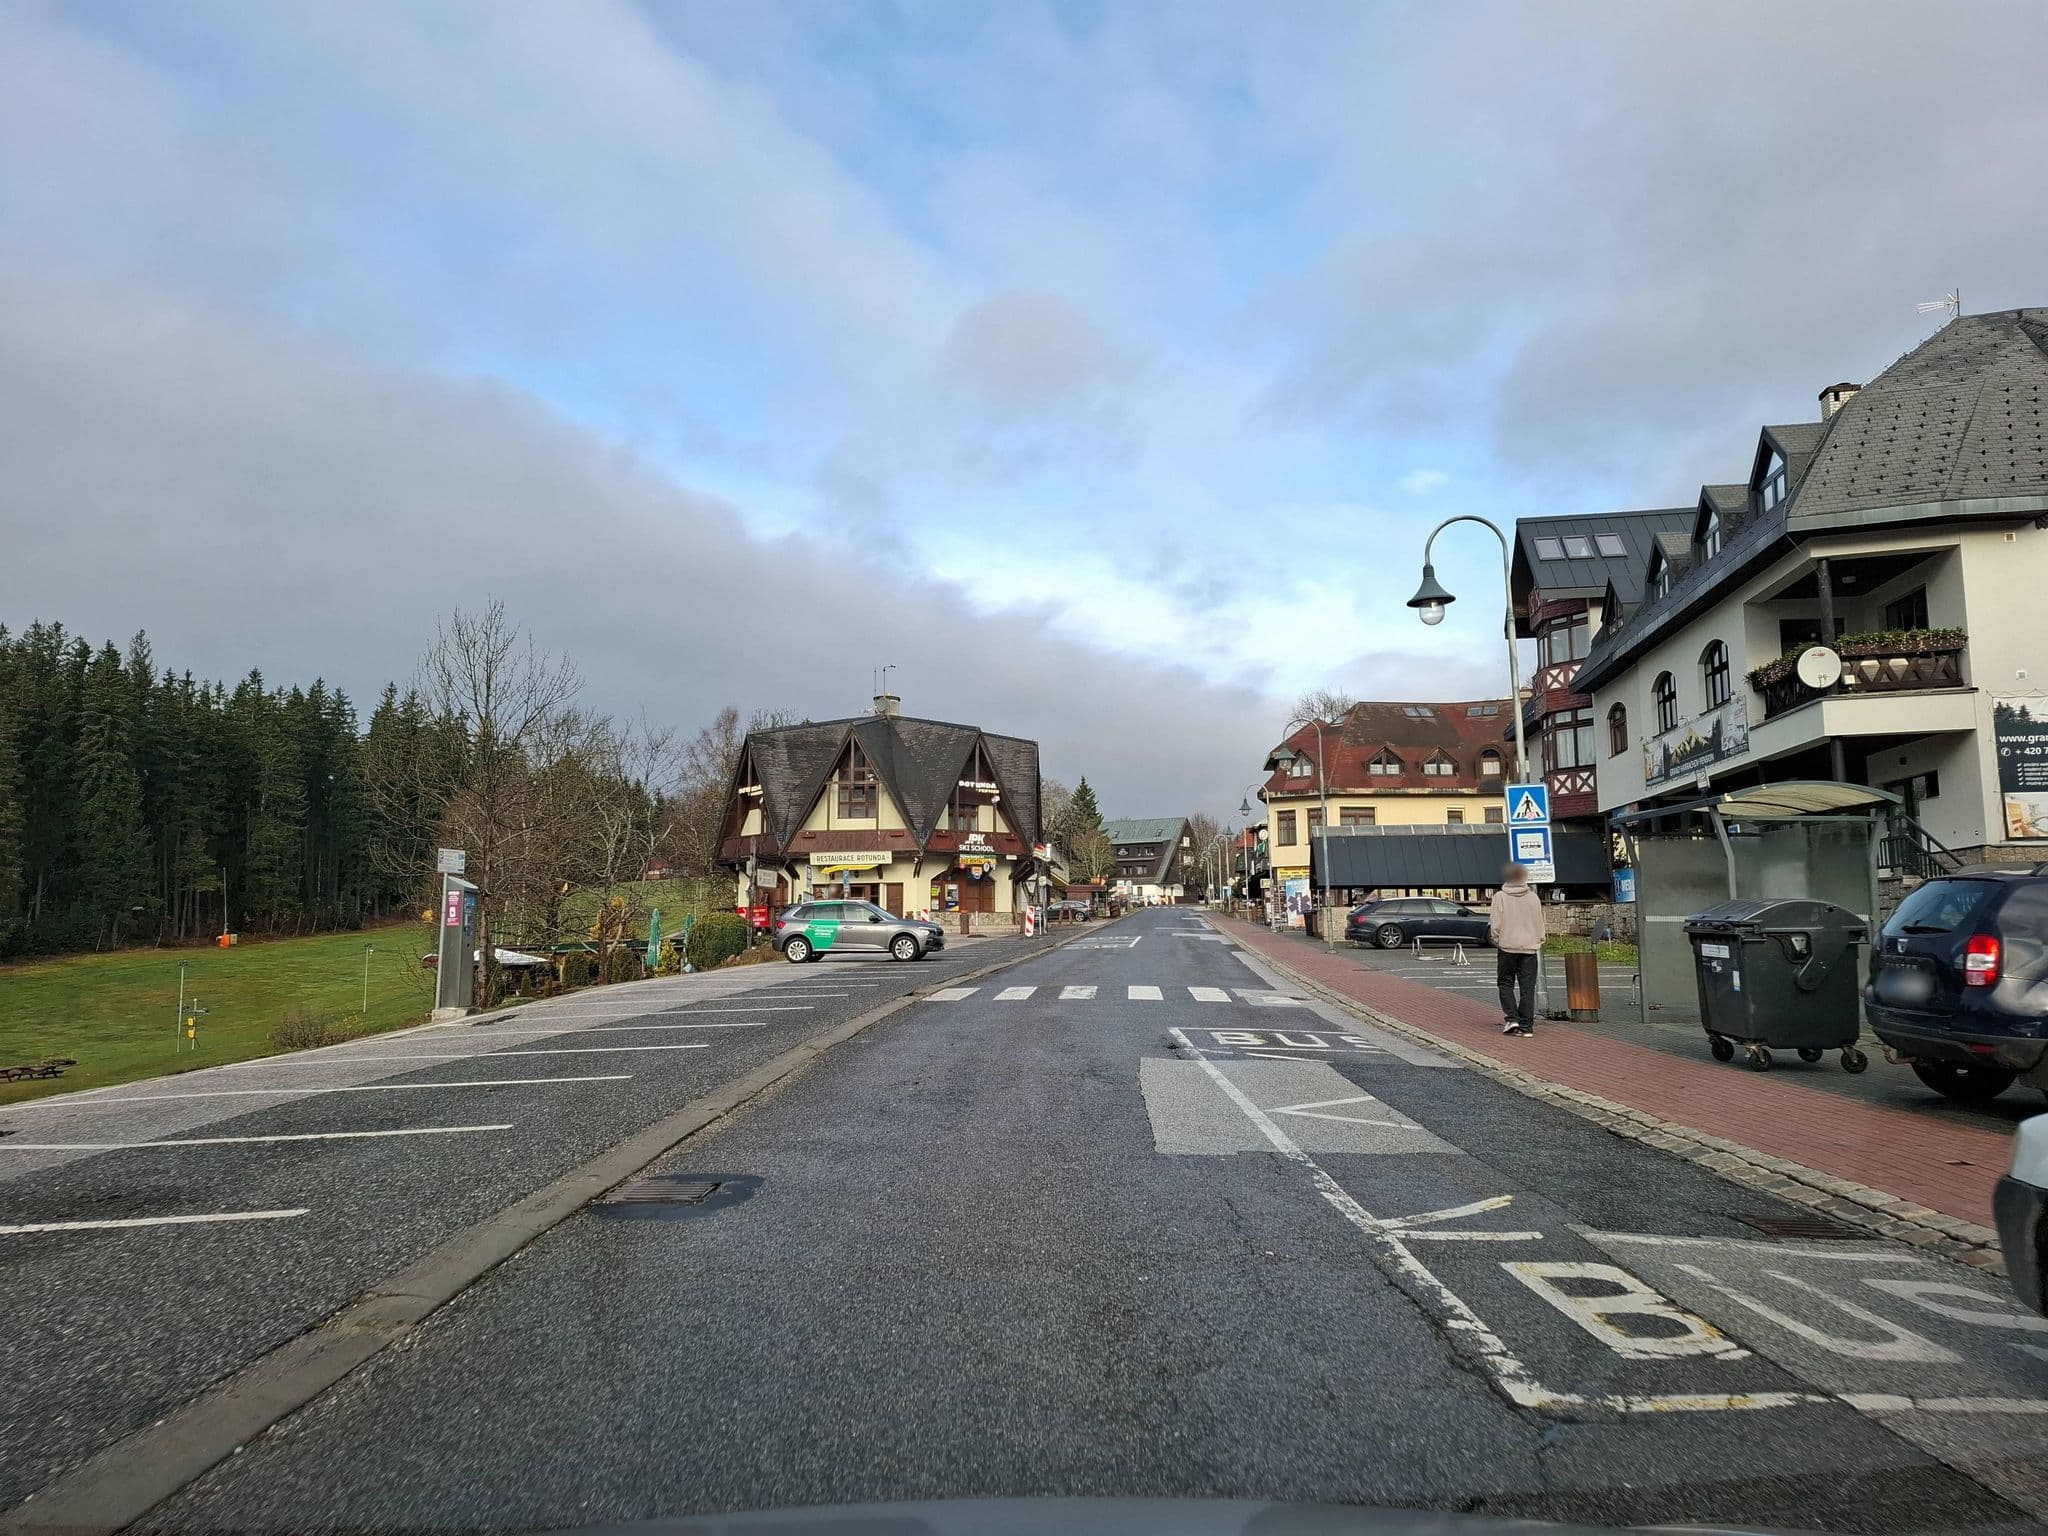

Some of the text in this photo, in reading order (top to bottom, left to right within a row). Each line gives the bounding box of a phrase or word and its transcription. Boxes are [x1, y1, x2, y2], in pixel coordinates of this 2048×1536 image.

[2024, 747, 2042, 755] 420
[965, 833, 986, 845] JPK
[959, 844, 995, 853] SKI SCHOOL
[816, 854, 886, 863] RESTAURACE ROTUNDA
